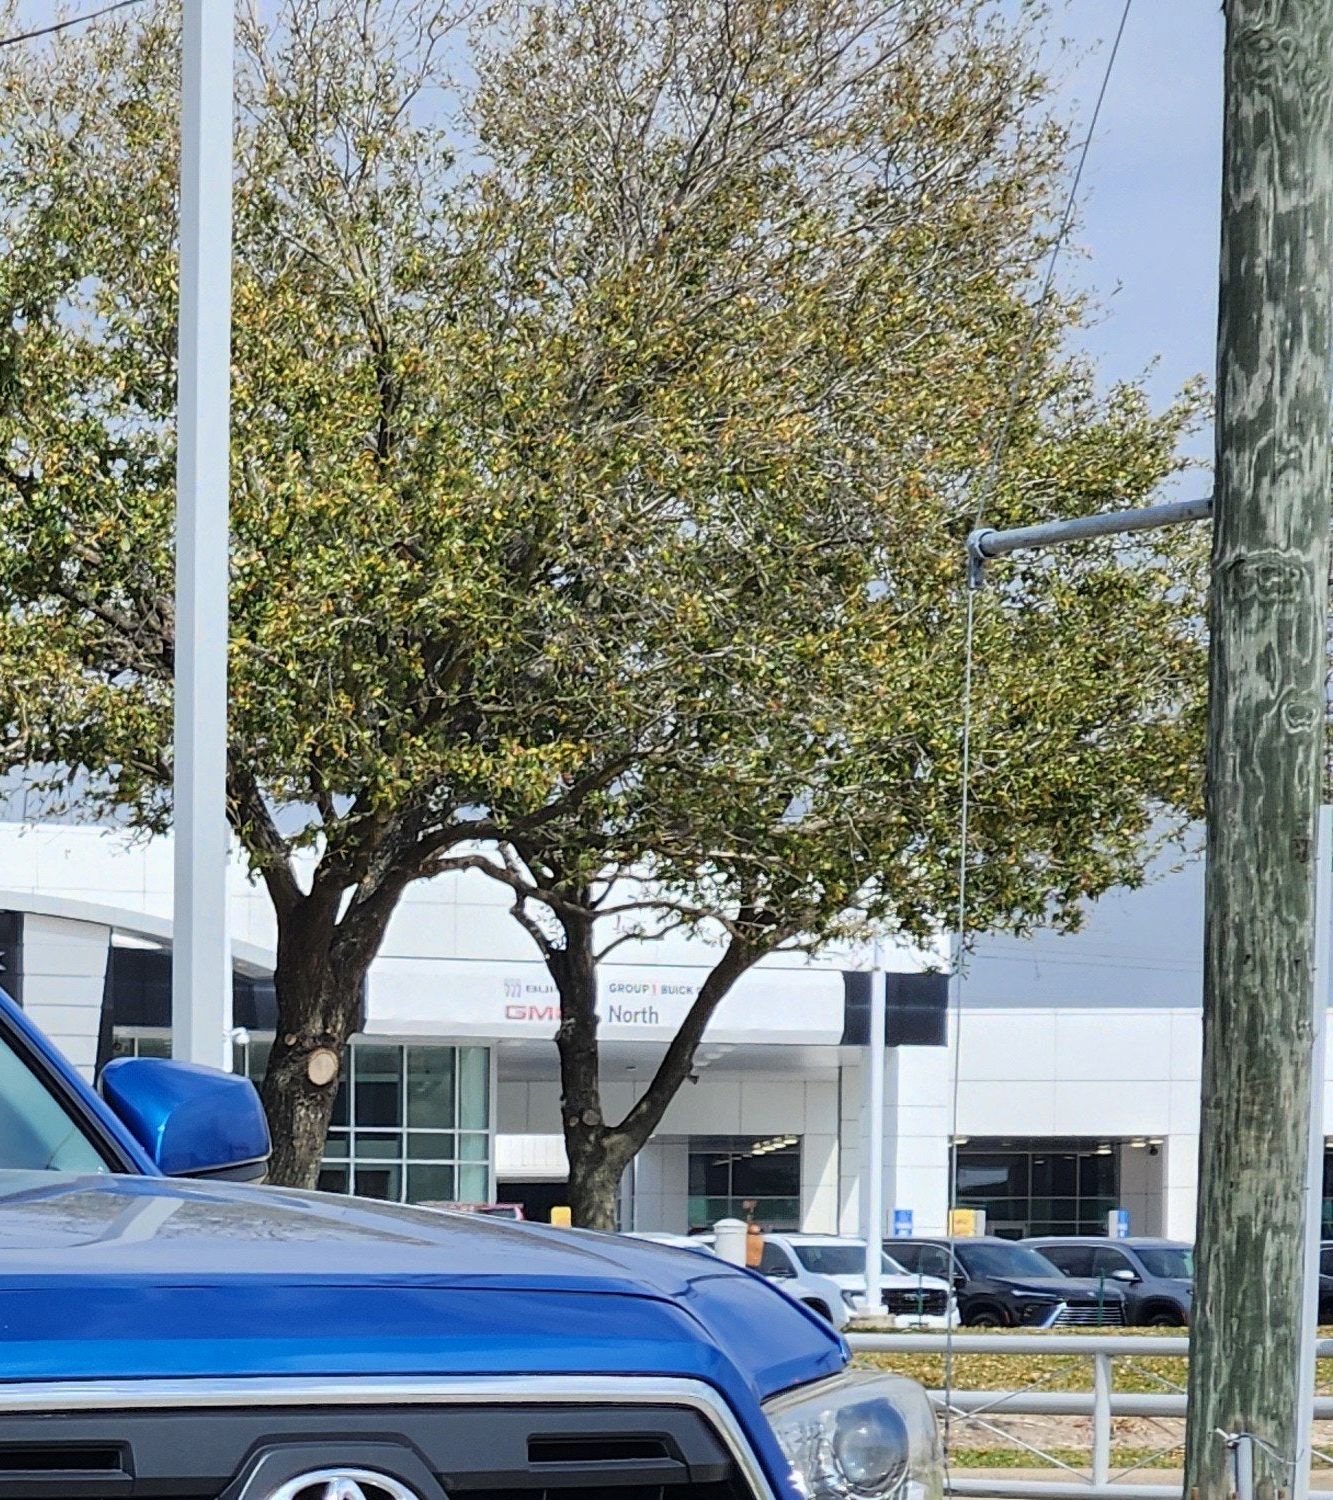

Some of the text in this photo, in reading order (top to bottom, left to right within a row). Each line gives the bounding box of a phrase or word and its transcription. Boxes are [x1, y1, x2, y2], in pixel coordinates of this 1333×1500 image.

[608, 983, 650, 995] GROUP
[660, 984, 694, 996] BUICK
[504, 1004, 561, 1021] GM
[609, 1005, 659, 1024] North
